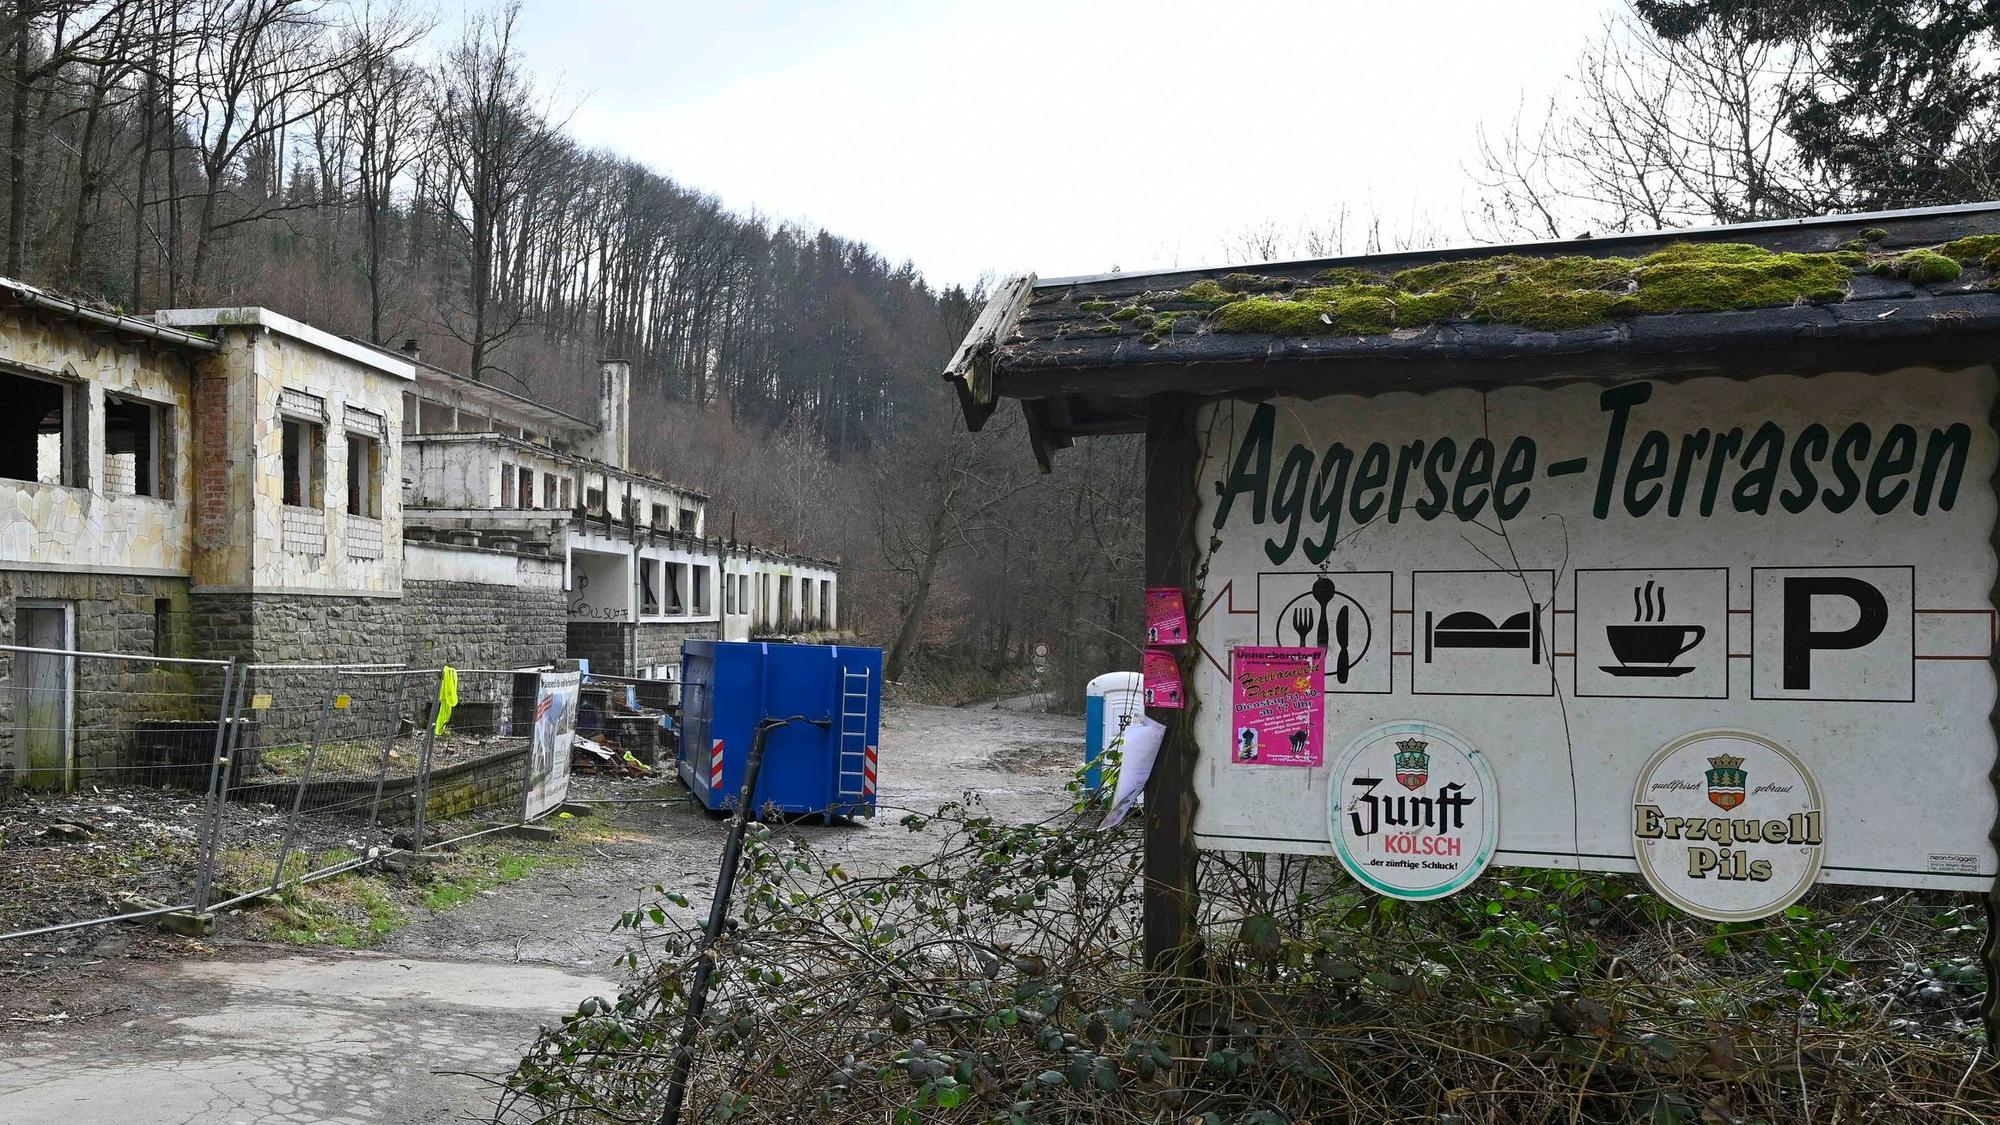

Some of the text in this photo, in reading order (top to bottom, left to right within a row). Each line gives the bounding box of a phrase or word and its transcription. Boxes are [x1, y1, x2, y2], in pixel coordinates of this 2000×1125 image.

[1212, 381, 1972, 566] Aggersee-Terrassen
[1784, 577, 1889, 690] P
[1235, 697, 1284, 713] Dienstag
[1245, 684, 1289, 700] Party
[1292, 699, 1313, 710] Uhr
[1651, 779, 1793, 796] quellfrisch gebraut
[1347, 777, 1477, 837] Zunft
[1634, 804, 1823, 847] Erzquell
[1384, 831, 1461, 857] KÖLSCH
[1385, 859, 1420, 870] zünftige
[1421, 860, 1459, 871] Schluck!
[1687, 846, 1774, 883] Pils
